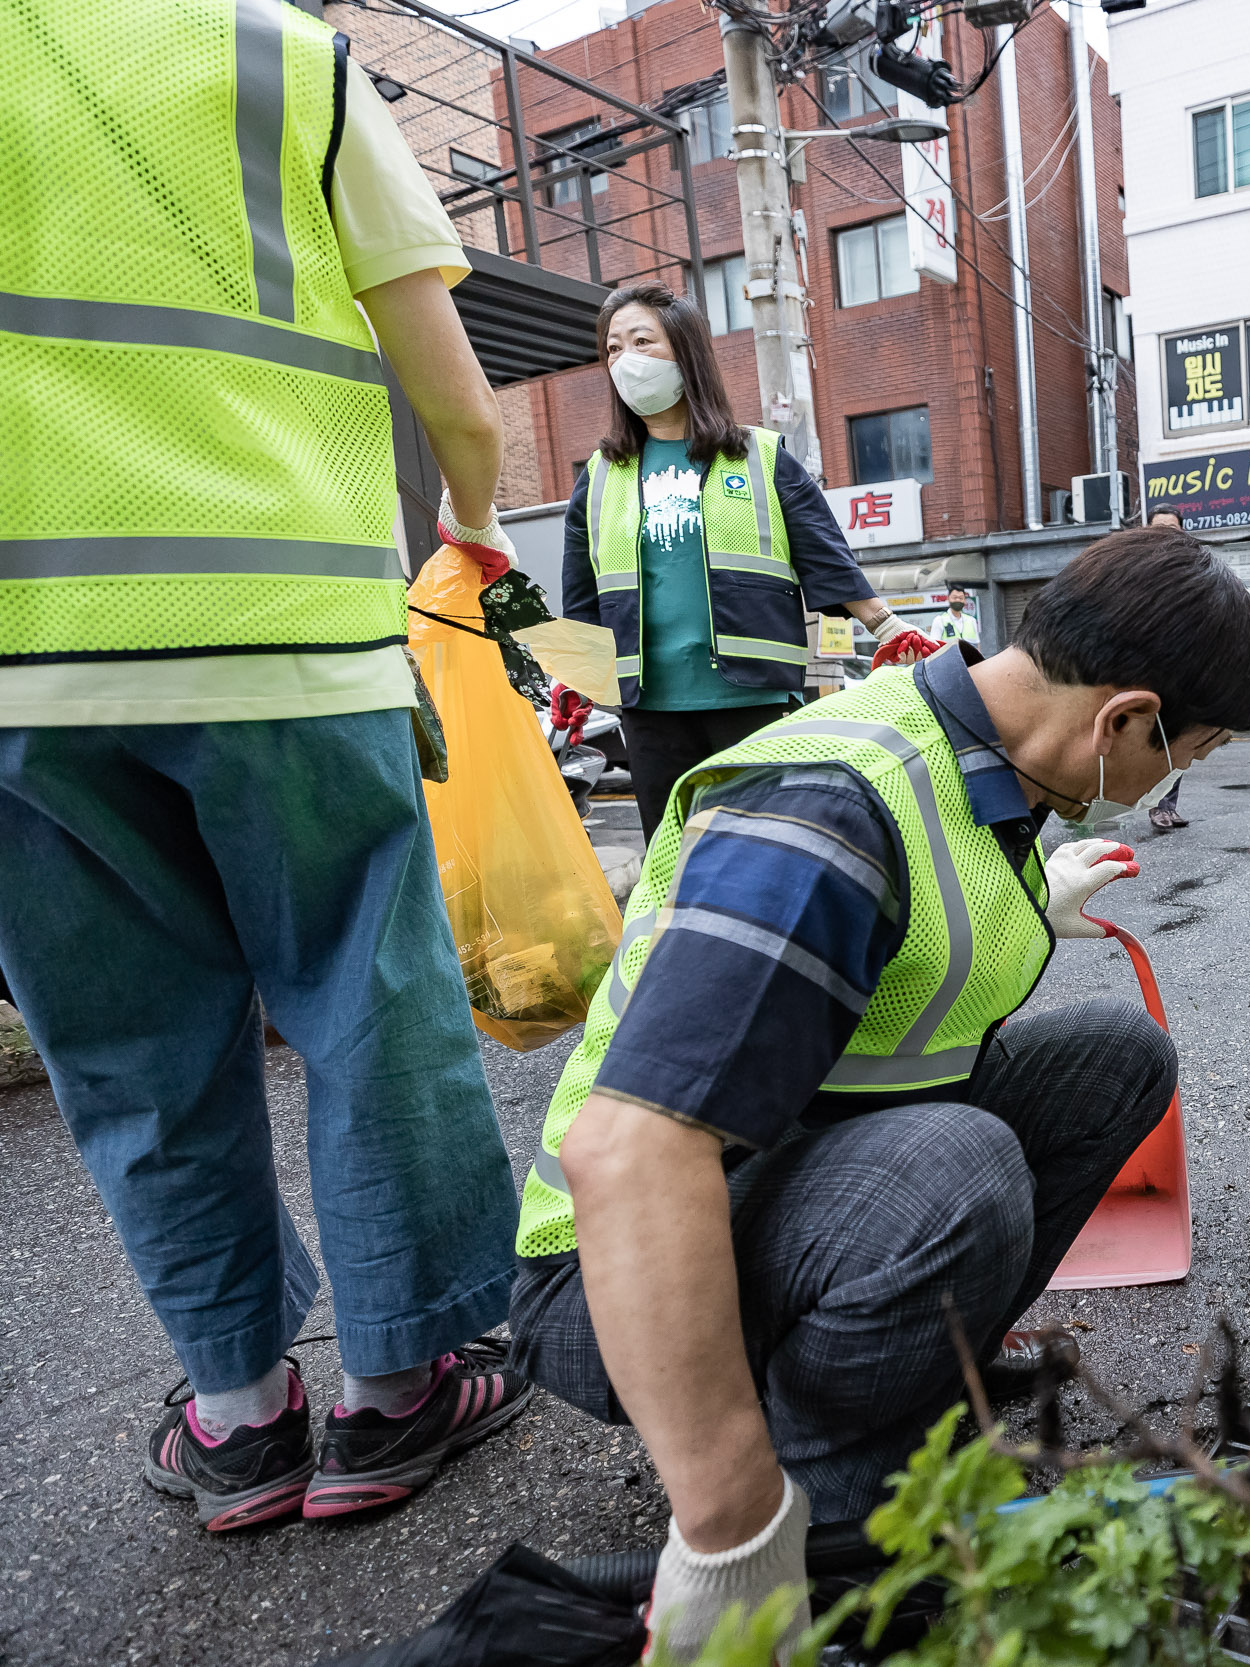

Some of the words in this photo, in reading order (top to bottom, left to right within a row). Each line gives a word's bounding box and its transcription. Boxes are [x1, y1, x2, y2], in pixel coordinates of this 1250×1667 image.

[1176, 335, 1215, 354] Music
[1215, 333, 1229, 347] In
[1184, 352, 1222, 379] 입시
[1186, 374, 1224, 401] 지도
[1148, 457, 1234, 498] music
[848, 491, 893, 530] 店
